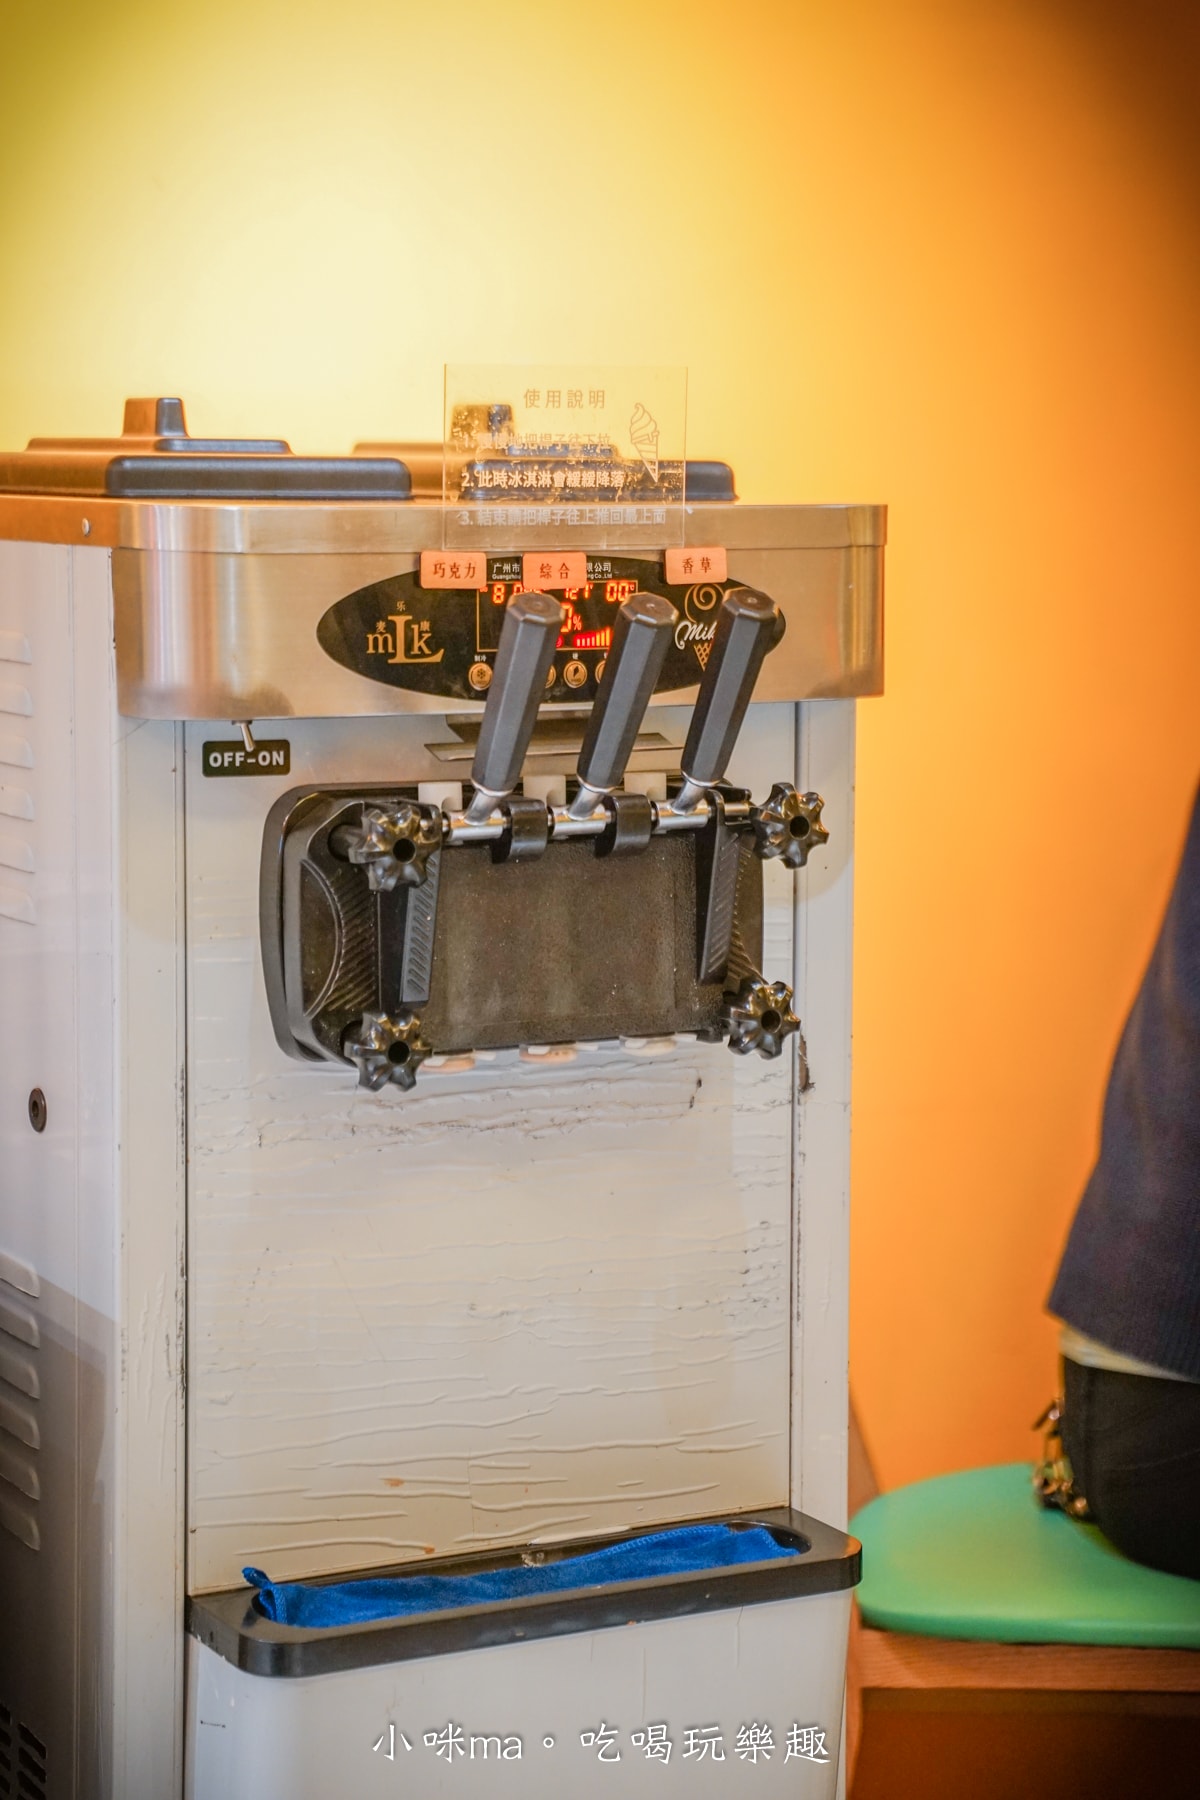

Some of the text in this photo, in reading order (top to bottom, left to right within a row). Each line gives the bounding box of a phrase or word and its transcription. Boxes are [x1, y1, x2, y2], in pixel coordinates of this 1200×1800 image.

[523, 389, 606, 409] 使用說明
[477, 470, 625, 489] 此時冰淇淋會緩緩降落
[433, 562, 476, 580] 巧克力
[493, 562, 520, 573] 广州市
[682, 556, 712, 574] 香草
[208, 750, 285, 768] OFF-ON
